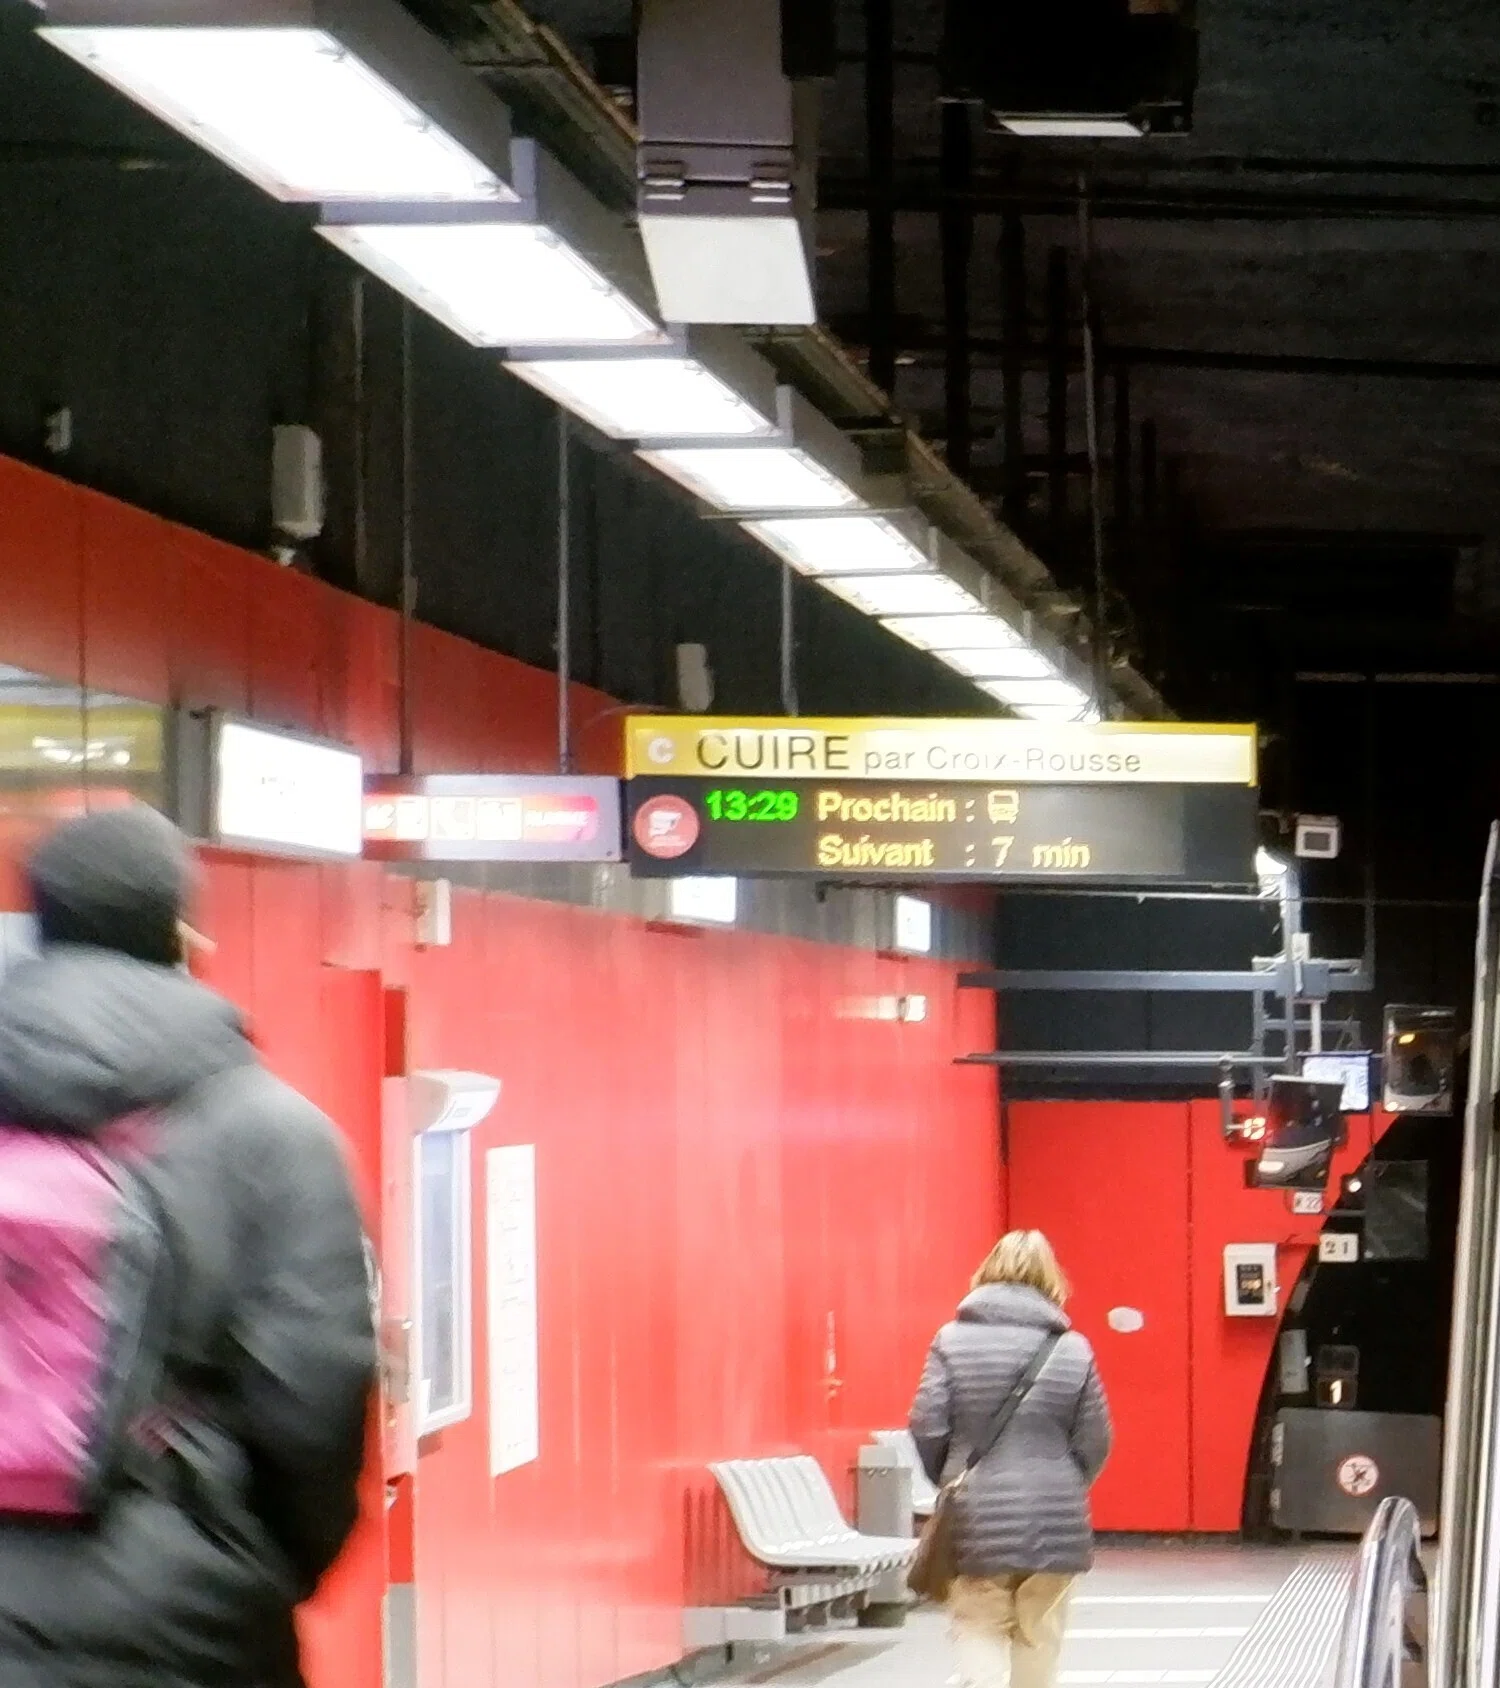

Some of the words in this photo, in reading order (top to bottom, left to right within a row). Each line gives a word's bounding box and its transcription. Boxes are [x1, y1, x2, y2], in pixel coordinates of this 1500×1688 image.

[648, 736, 675, 764] C
[697, 734, 850, 770] CUIRE
[864, 751, 915, 774] par
[926, 745, 1142, 773] Croix-Rousse
[706, 789, 799, 821] 13:29
[817, 789, 957, 822] Prochain
[817, 833, 935, 867] Suivant
[991, 835, 1015, 868] 7
[1031, 836, 1091, 868] min
